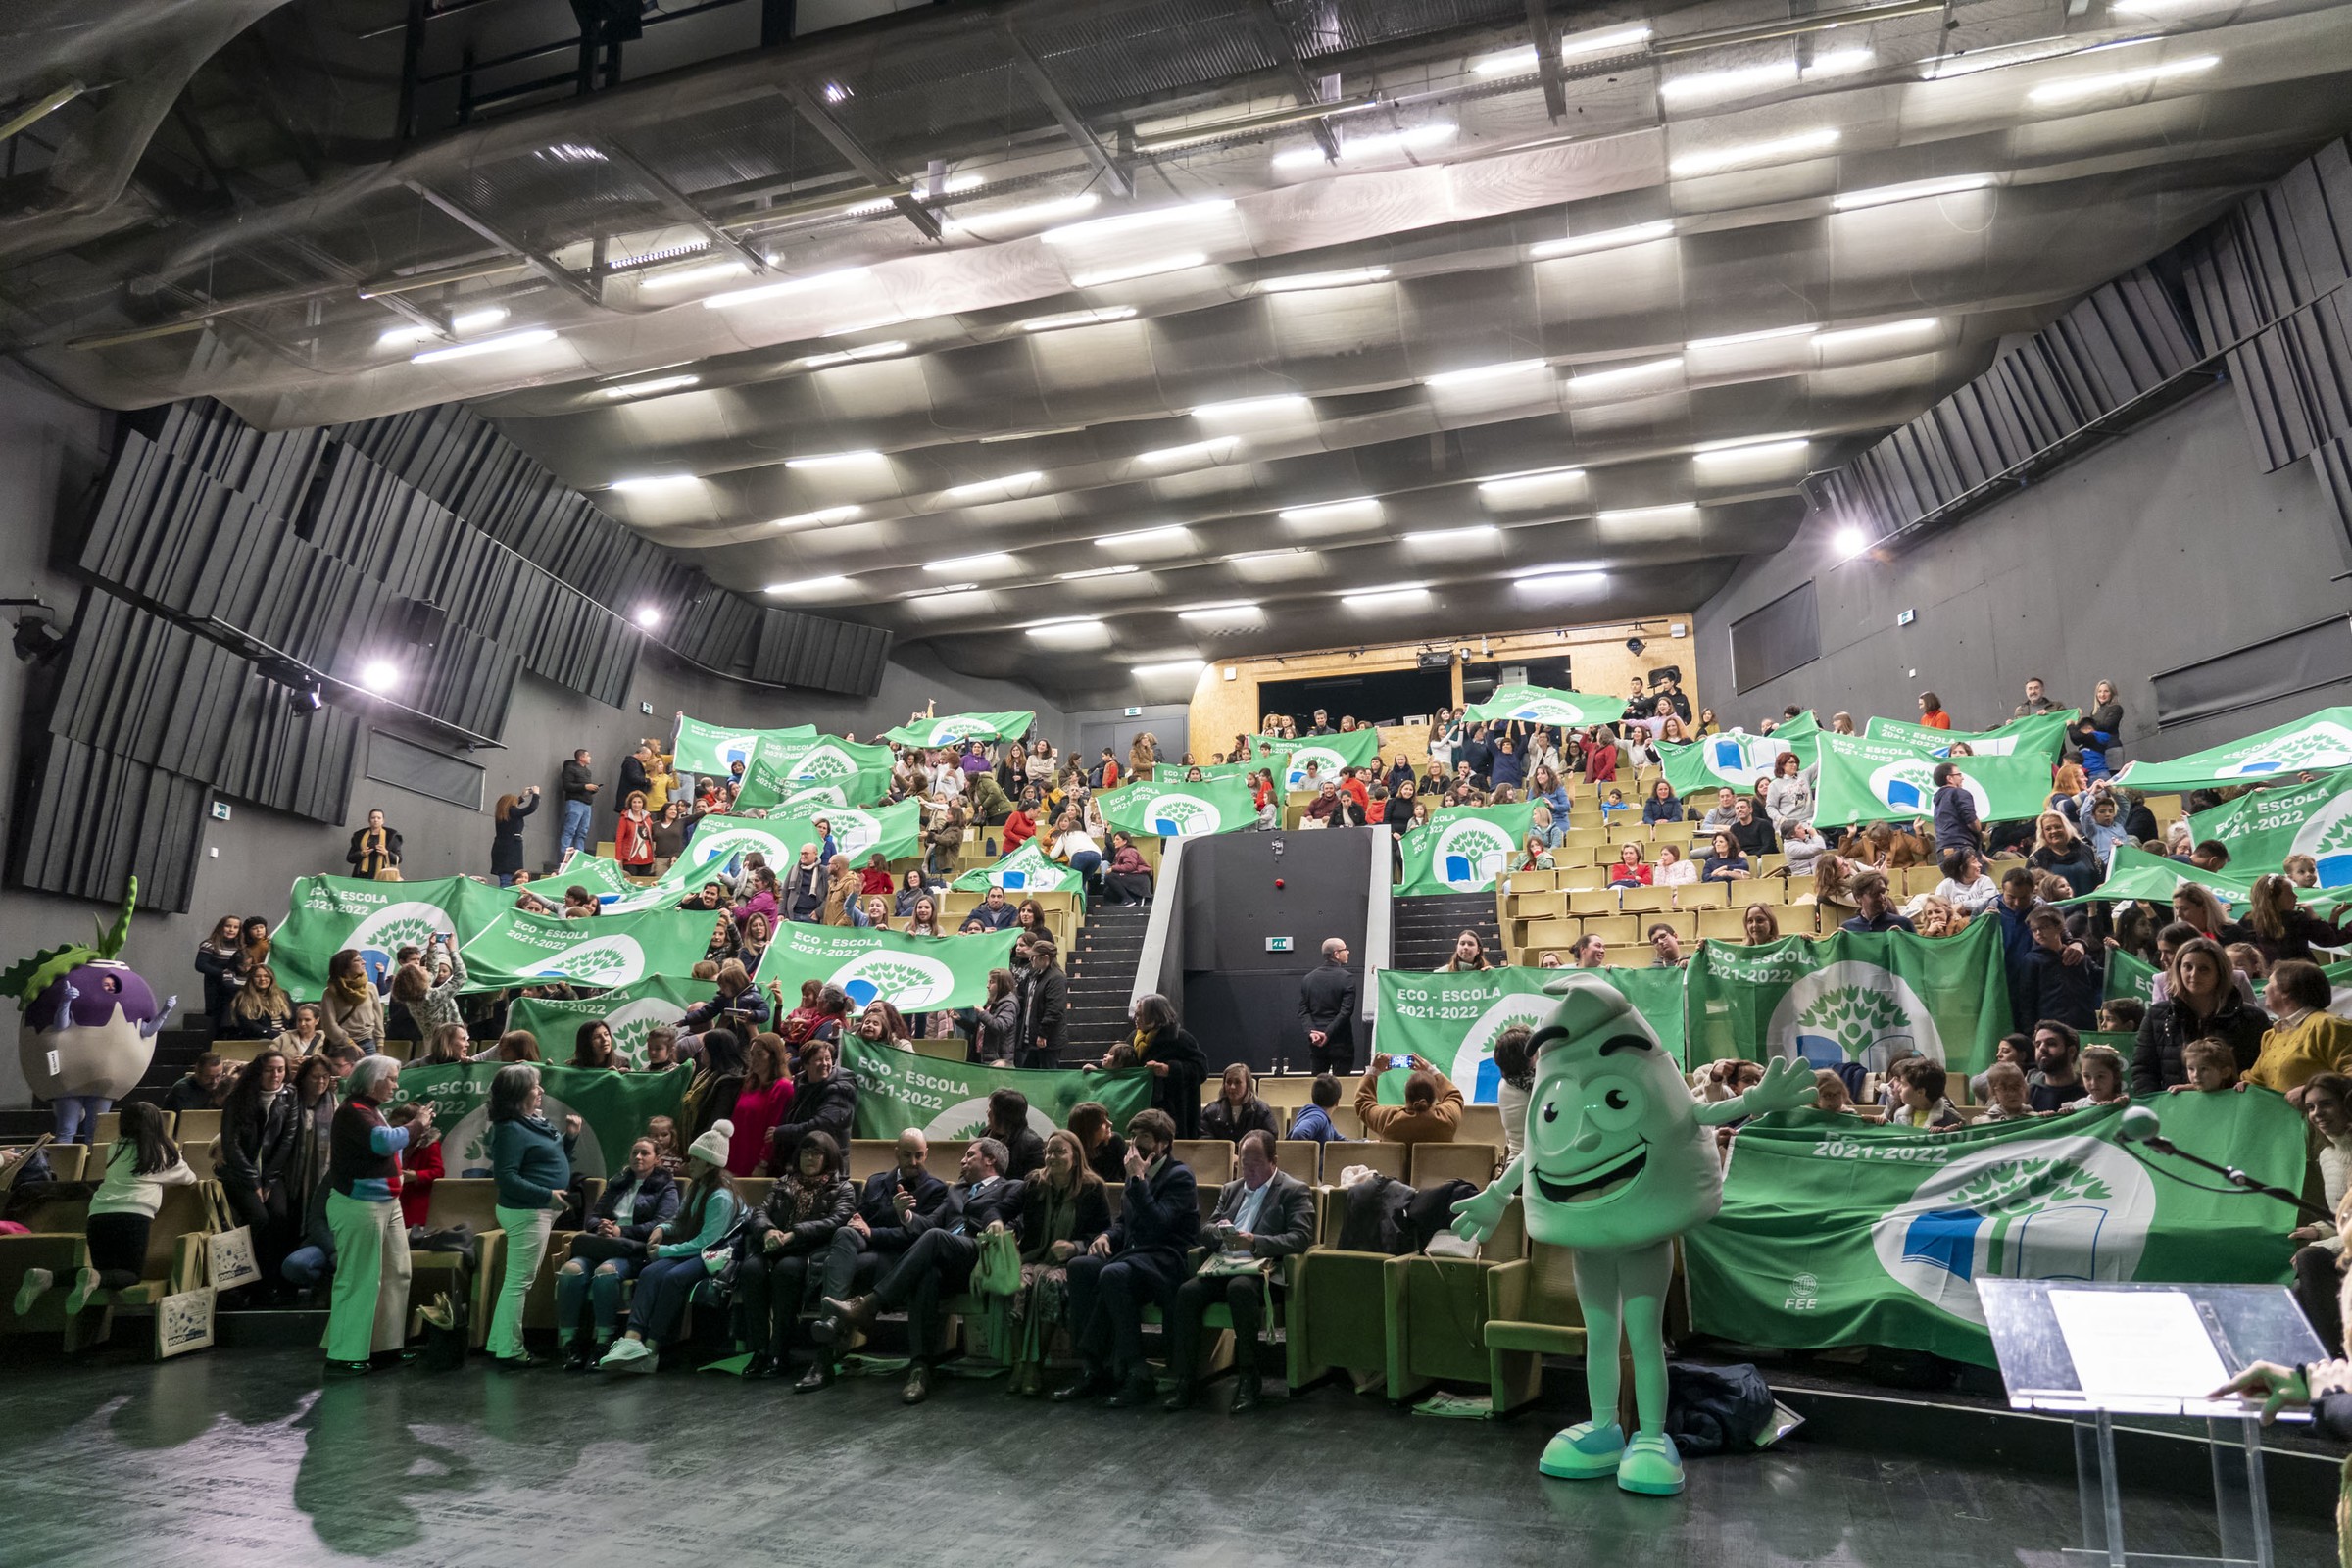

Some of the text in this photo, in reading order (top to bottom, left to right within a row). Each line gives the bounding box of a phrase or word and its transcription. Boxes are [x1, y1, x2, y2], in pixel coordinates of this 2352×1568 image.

[1881, 729, 1937, 749] 2021-2022
[1882, 723, 1904, 734] ECO
[1912, 732, 1956, 745] ESCOLA
[1832, 738, 1855, 750] ECO
[1865, 746, 1914, 757] ESCOLA
[1109, 794, 1126, 806] ECO
[1131, 786, 1161, 797] ESCOLA
[2257, 787, 2330, 815] ESCOLA
[310, 886, 331, 898] ECO
[340, 890, 389, 903] ESCOLA
[304, 899, 369, 916] 2021-2022
[513, 919, 538, 933] ECO
[545, 929, 589, 940] ESCOLA
[794, 930, 821, 945] ECO
[831, 938, 883, 948] ESCOLA
[506, 929, 567, 951] 2021-2022
[789, 941, 860, 957] 2021-2022
[1750, 950, 1818, 967] ESCOLA
[1397, 988, 1428, 1001] ECO
[1441, 986, 1502, 1003] ESCOLA
[1396, 1003, 1479, 1019] 2021-2022
[858, 1056, 892, 1076] ECO
[905, 1070, 970, 1096] ESCOLA
[856, 1073, 943, 1110] 2021-2022
[1812, 1140, 1949, 1163] 2021-2022
[1784, 1298, 1819, 1310] FEE
